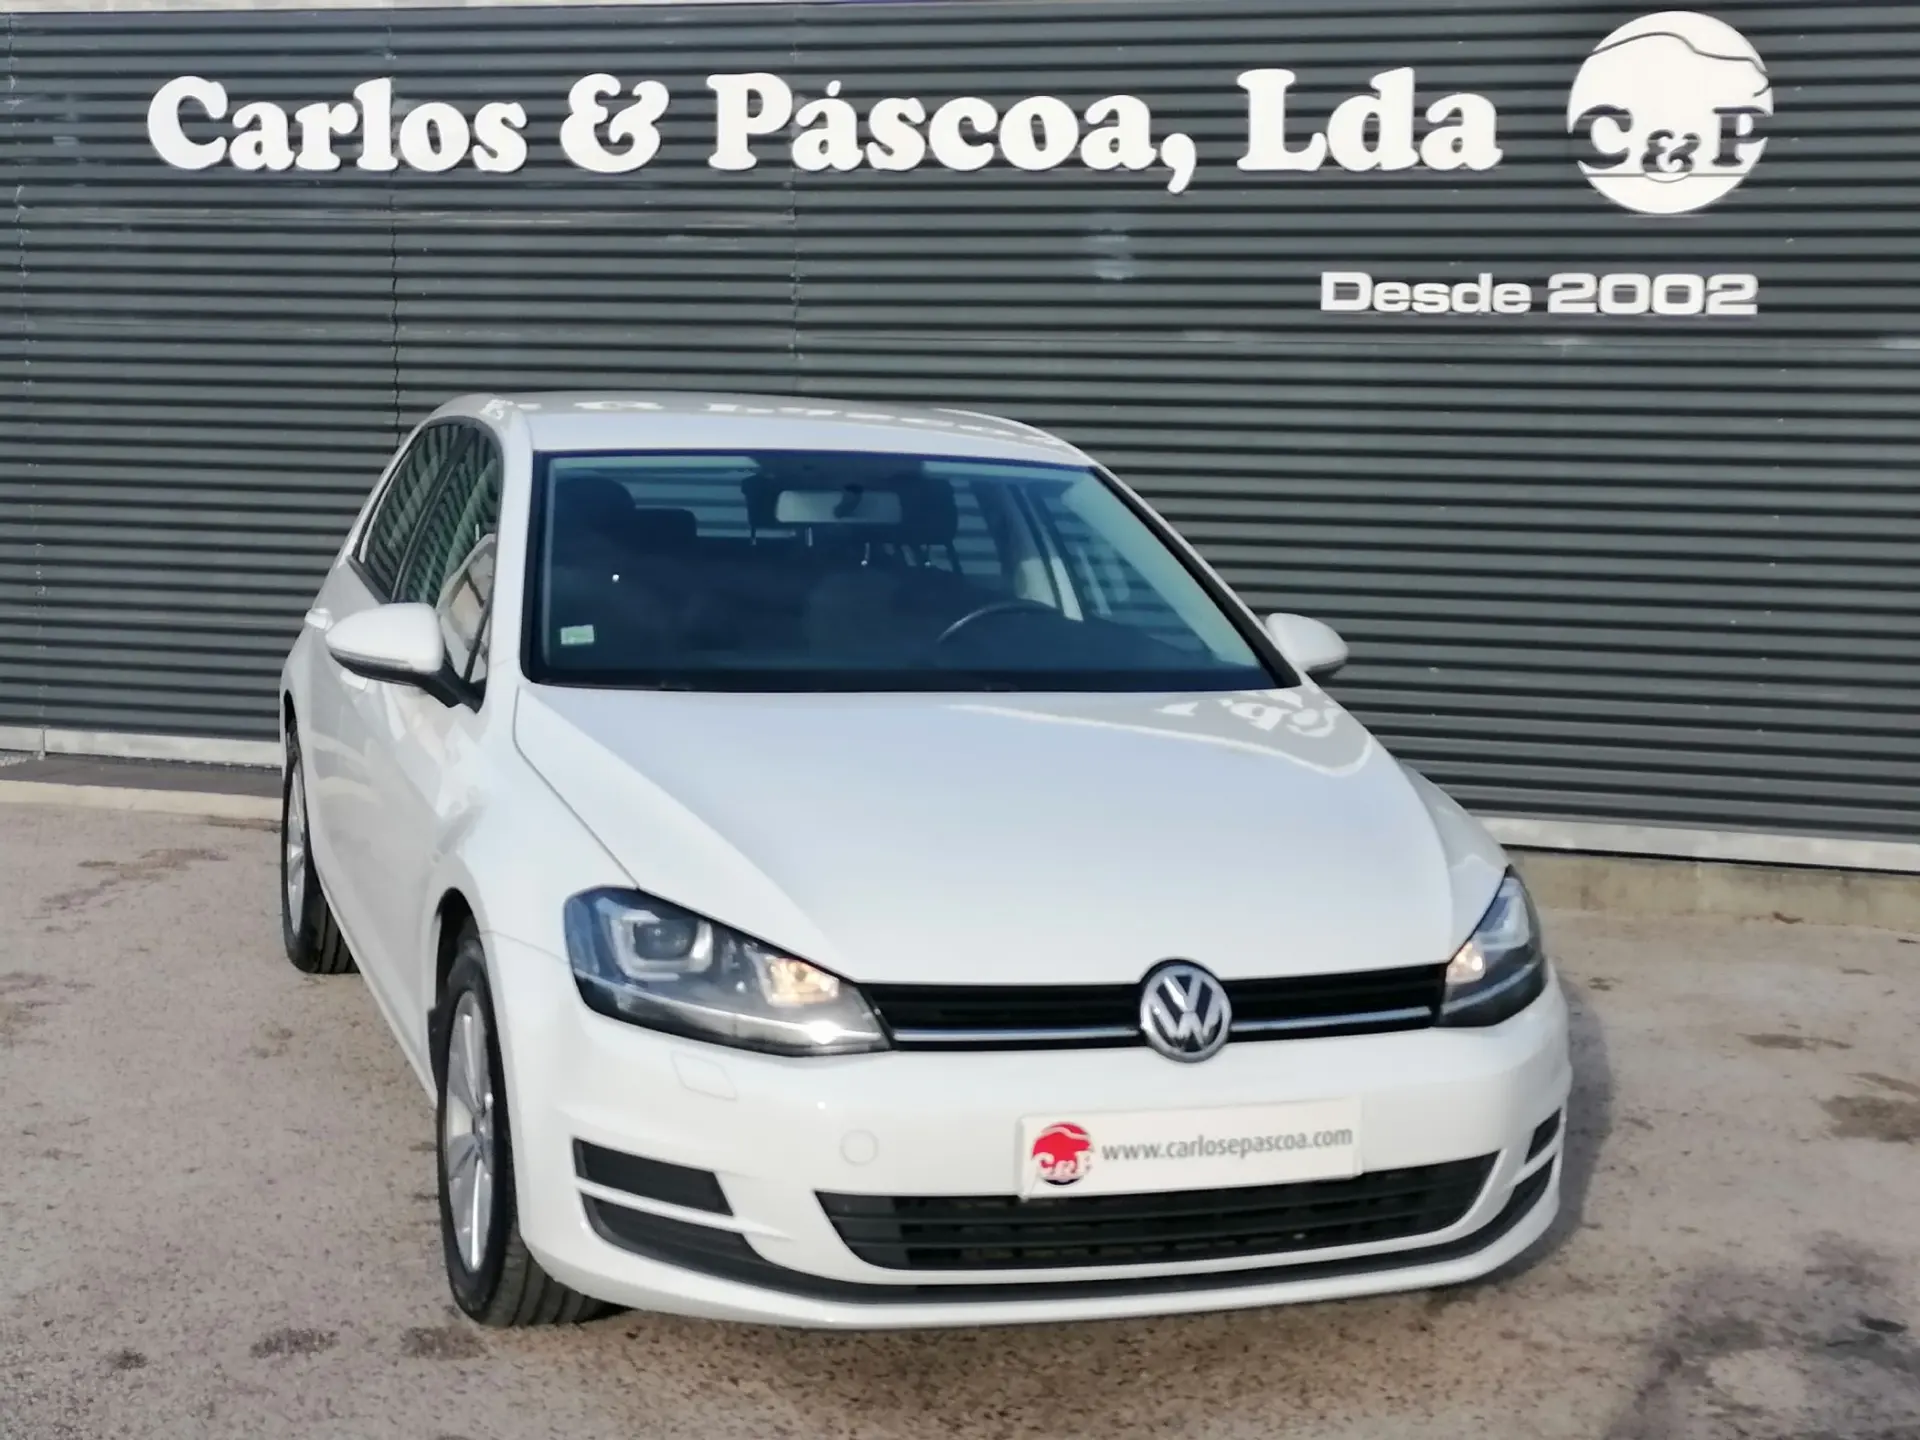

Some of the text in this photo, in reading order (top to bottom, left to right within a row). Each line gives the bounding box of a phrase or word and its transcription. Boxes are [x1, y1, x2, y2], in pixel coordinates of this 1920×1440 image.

[147, 67, 1502, 193] Carlos & Páscoa, Lda
[1321, 272, 1758, 316] Desde 2002
[1101, 1127, 1353, 1160] www.carlosepascoa.com
